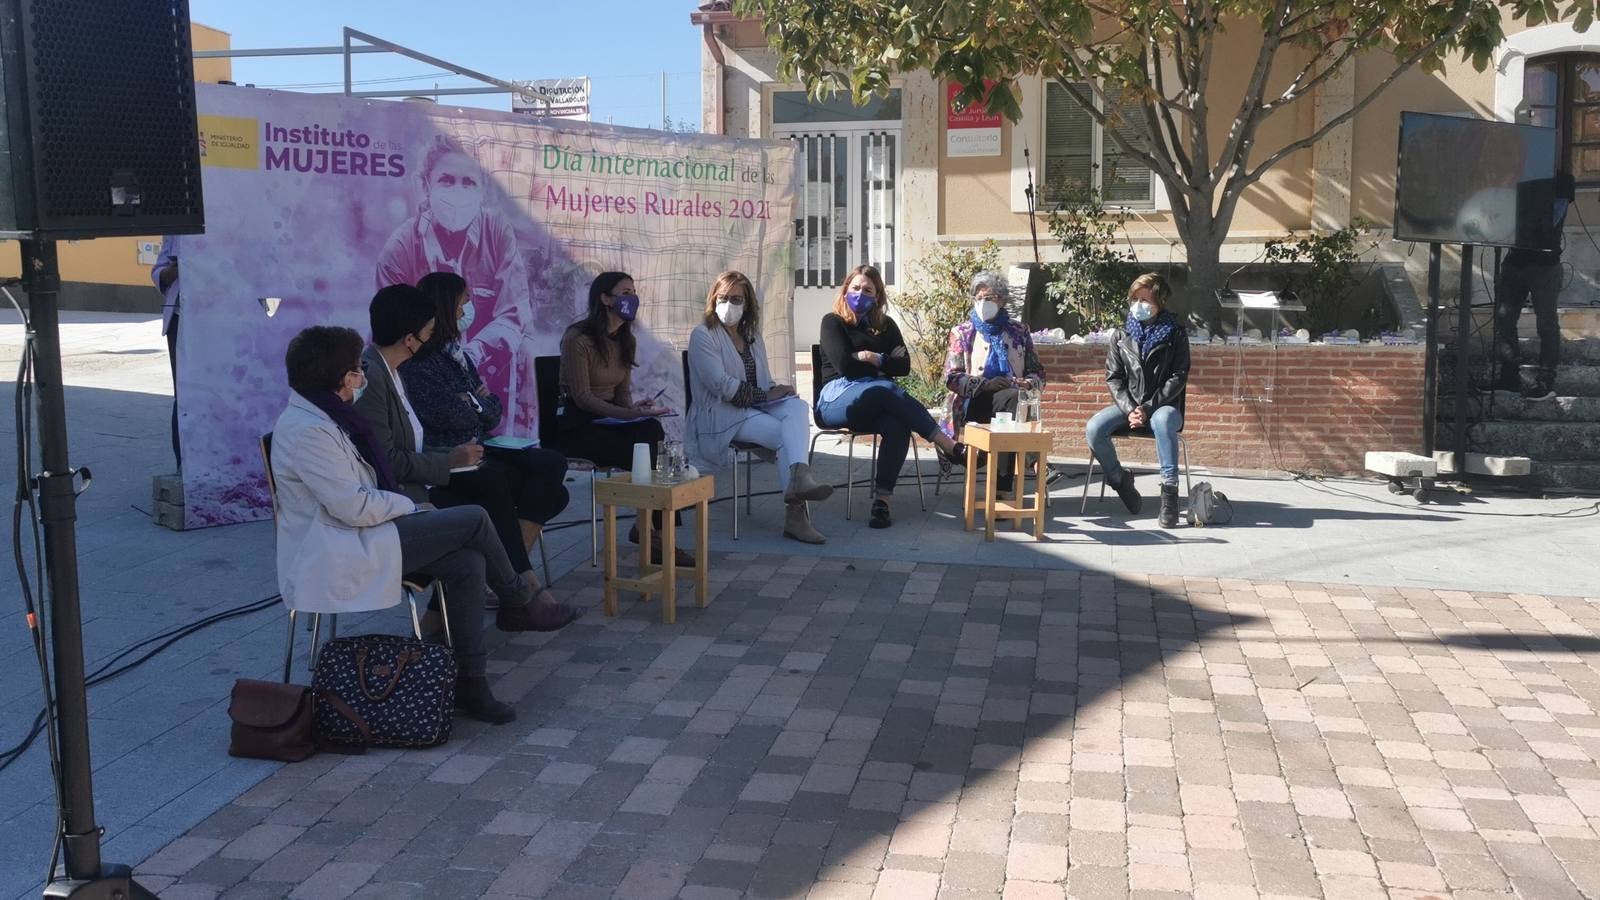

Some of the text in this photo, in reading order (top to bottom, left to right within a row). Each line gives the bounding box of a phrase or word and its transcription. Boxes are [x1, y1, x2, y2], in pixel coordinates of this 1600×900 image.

[210, 134, 244, 142] MINISTERIO
[265, 122, 402, 151] Instituto de las
[950, 134, 998, 143] Consultorio
[265, 146, 406, 178] MUJERES
[543, 144, 775, 185] Día internacional de las
[545, 184, 772, 220] Mujeres Rurales 2021
